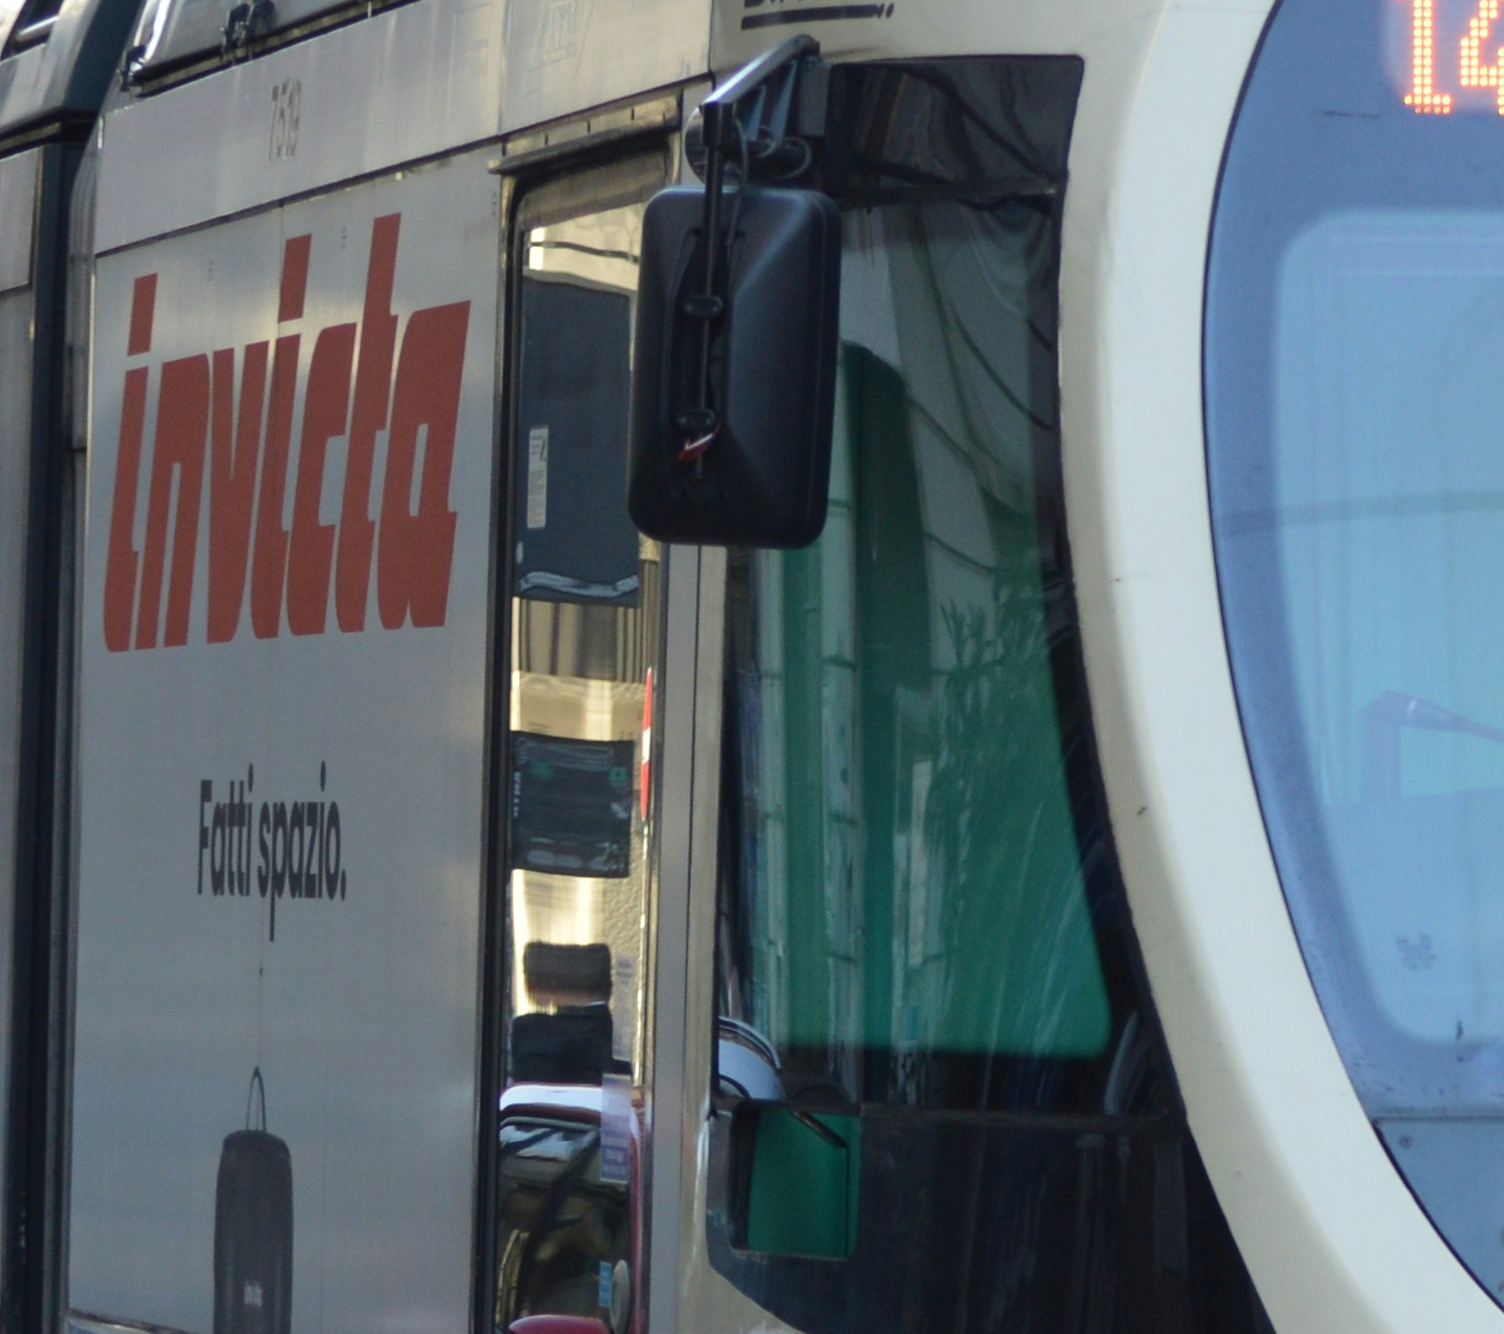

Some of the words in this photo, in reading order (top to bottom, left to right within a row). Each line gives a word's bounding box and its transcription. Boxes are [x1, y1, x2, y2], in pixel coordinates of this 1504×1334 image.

[102, 212, 471, 653] invicta
[197, 762, 253, 897] Fatti
[257, 760, 347, 943] spazio.
